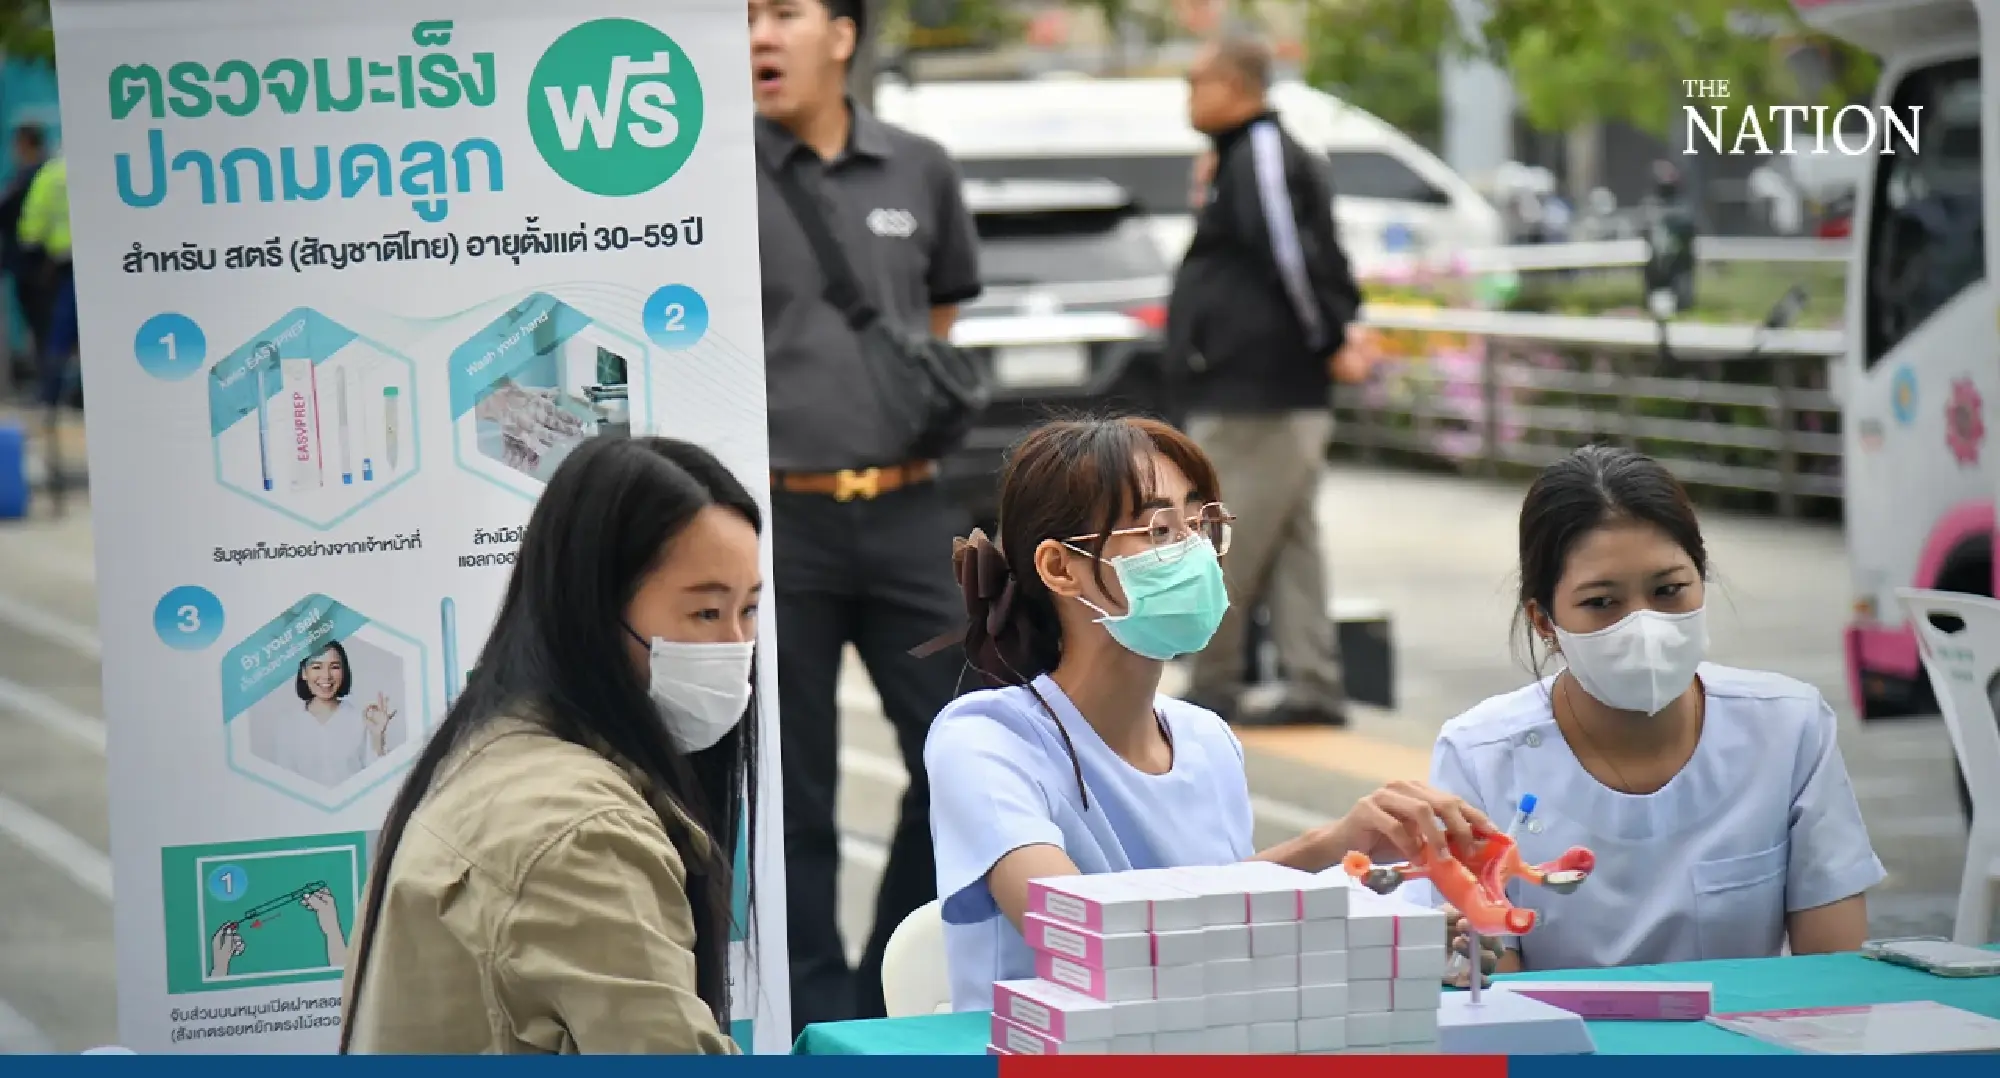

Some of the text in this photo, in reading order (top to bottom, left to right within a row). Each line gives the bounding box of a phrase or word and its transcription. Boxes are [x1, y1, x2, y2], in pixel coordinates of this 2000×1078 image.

[108, 20, 496, 120] ตรวจมะเร็ง
[544, 51, 679, 151] ฟรี
[114, 128, 504, 223] ปากมดลูก
[123, 242, 216, 272] สำหรับ
[225, 236, 284, 269] สตรี
[290, 230, 459, 272] (สัญชาติไทย)
[466, 216, 588, 266] อายุตั้งแต่
[680, 216, 704, 246] ปี
[497, 332, 521, 358] your
[520, 309, 549, 336] hand
[665, 303, 685, 331] 2
[159, 332, 176, 360] 1
[177, 605, 201, 632] 3
[241, 651, 260, 671] By
[262, 628, 293, 659] your
[221, 872, 232, 893] 1
